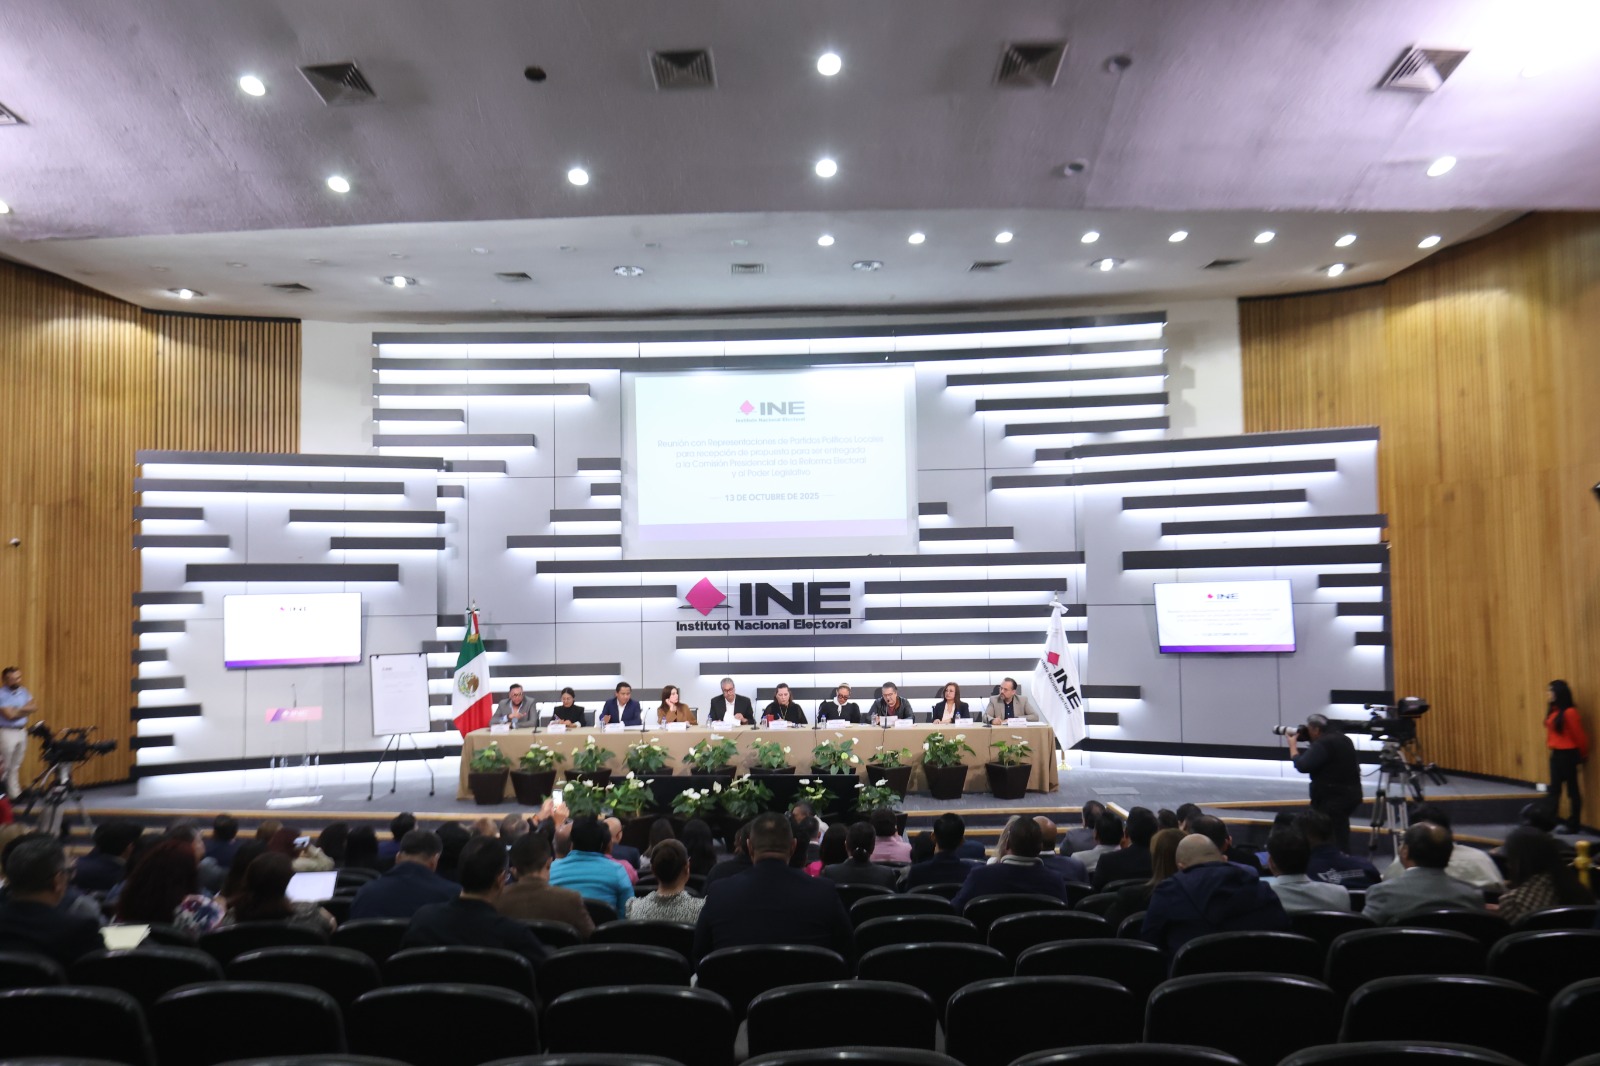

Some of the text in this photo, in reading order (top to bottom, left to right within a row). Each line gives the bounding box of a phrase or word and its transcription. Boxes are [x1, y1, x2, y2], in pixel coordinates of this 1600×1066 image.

[760, 401, 805, 416] INE
[708, 438, 777, 447] Representaciones
[778, 437, 789, 445] de
[790, 436, 821, 444] Partidos
[854, 435, 884, 443] Locales
[676, 450, 695, 458] para
[750, 448, 790, 457] propuesta
[790, 448, 810, 456] para
[682, 460, 691, 468] la
[730, 458, 776, 467] Presidencial
[798, 457, 832, 465] Reforma
[833, 456, 867, 464] Electoral
[731, 468, 812, 478] y al Poder Legislativo
[748, 493, 786, 501] OCTUBRE
[787, 492, 798, 500] DE
[739, 581, 851, 616] INE
[676, 619, 852, 632] Instituto Nacional Electoral
[1053, 668, 1082, 710] INE
